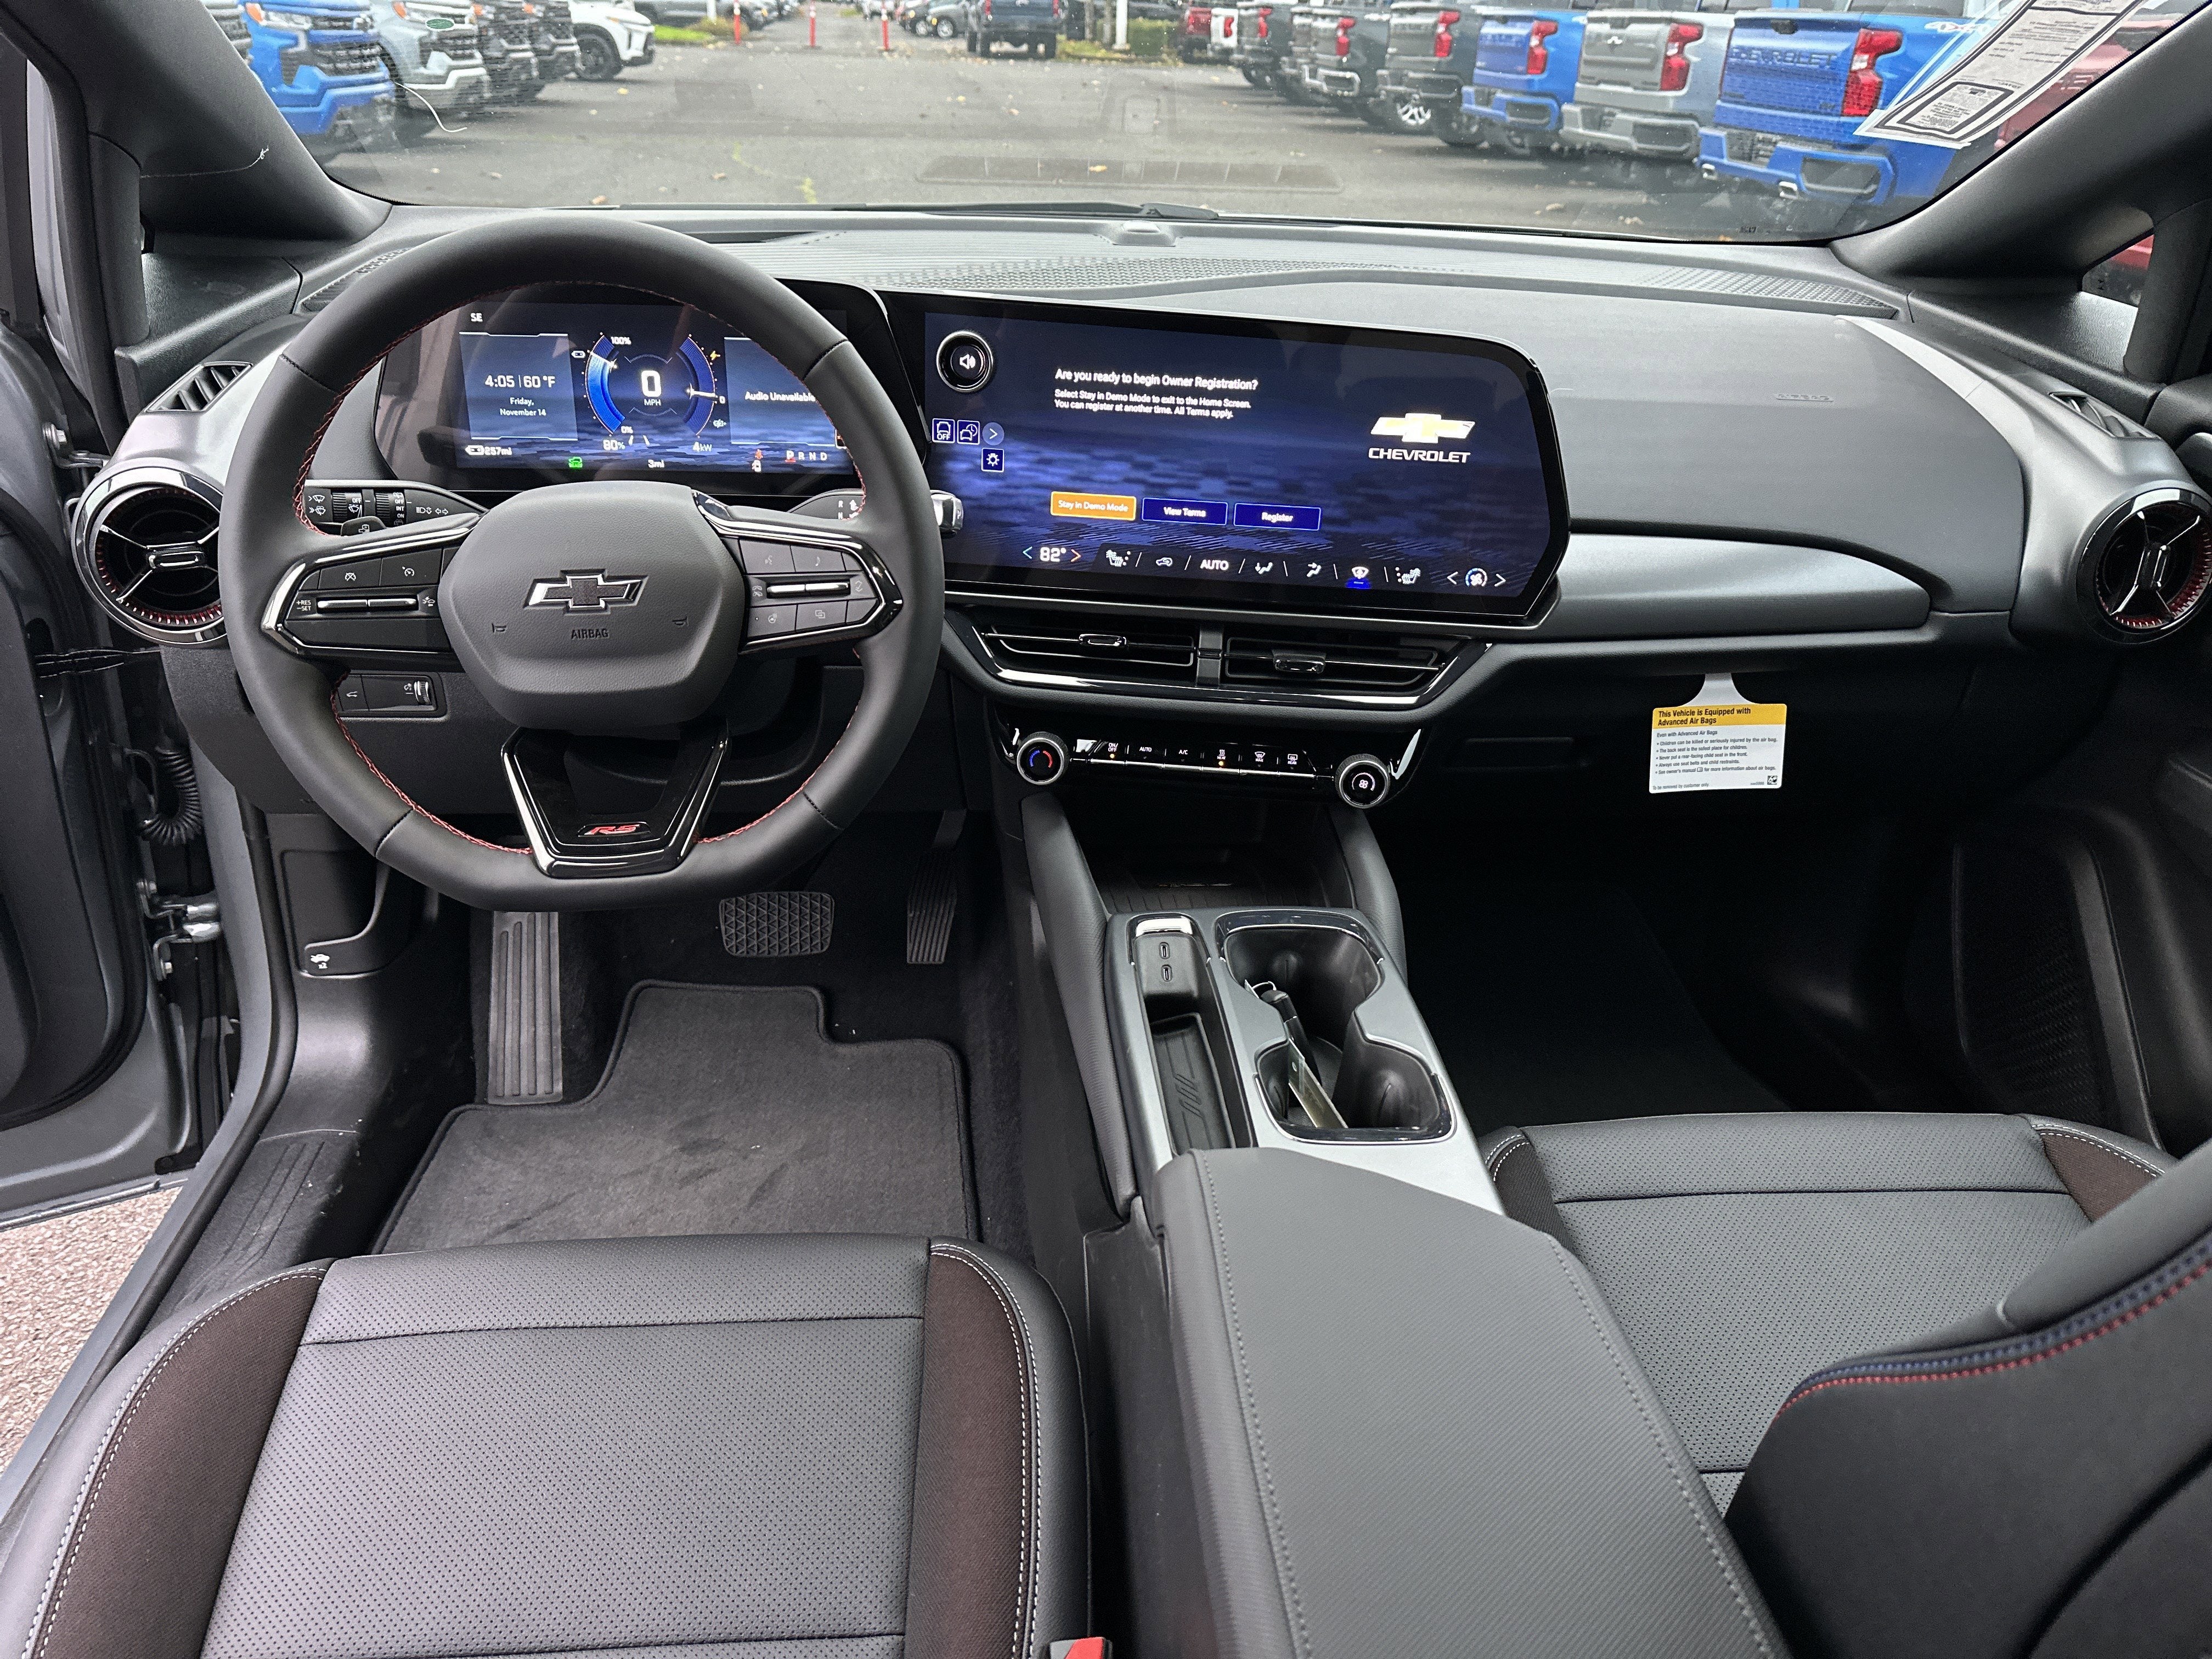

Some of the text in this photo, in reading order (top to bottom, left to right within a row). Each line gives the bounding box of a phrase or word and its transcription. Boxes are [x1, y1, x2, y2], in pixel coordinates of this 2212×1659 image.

[471, 313, 483, 322] SE
[611, 336, 631, 345] 100%
[484, 375, 515, 388] 4:05
[523, 375, 541, 388] 60
[641, 370, 662, 397] 0
[1055, 368, 1259, 390] Are you ready to begin Owner Registration?
[510, 397, 534, 406] Friday,
[745, 391, 816, 402] Audio Unavailable
[1054, 388, 1251, 408] Select Stay in Demo Mode to exit to the Home Screen.
[500, 408, 536, 416] November
[1054, 399, 1069, 408] You
[1085, 402, 1114, 411] register
[1115, 403, 1124, 411] at
[1124, 404, 1153, 413] another
[1154, 405, 1172, 414] time.
[1174, 406, 1185, 415] All
[1186, 407, 1210, 416] Terms
[1211, 408, 1234, 419] apply.
[620, 426, 633, 434] 0%
[603, 439, 625, 450] 80%
[786, 450, 827, 461] P R N D
[1368, 447, 1471, 463] CHEVROLET
[1058, 500, 1128, 512] Stay in Demo Mode
[1163, 506, 1206, 517] View Terms
[1261, 512, 1294, 523] Register
[1200, 559, 1229, 571] AUTO
[571, 628, 608, 640] AIRBAG
[1672, 709, 1695, 717] Vehicle
[1705, 708, 1735, 716] Equipped
[584, 824, 640, 836] RS
